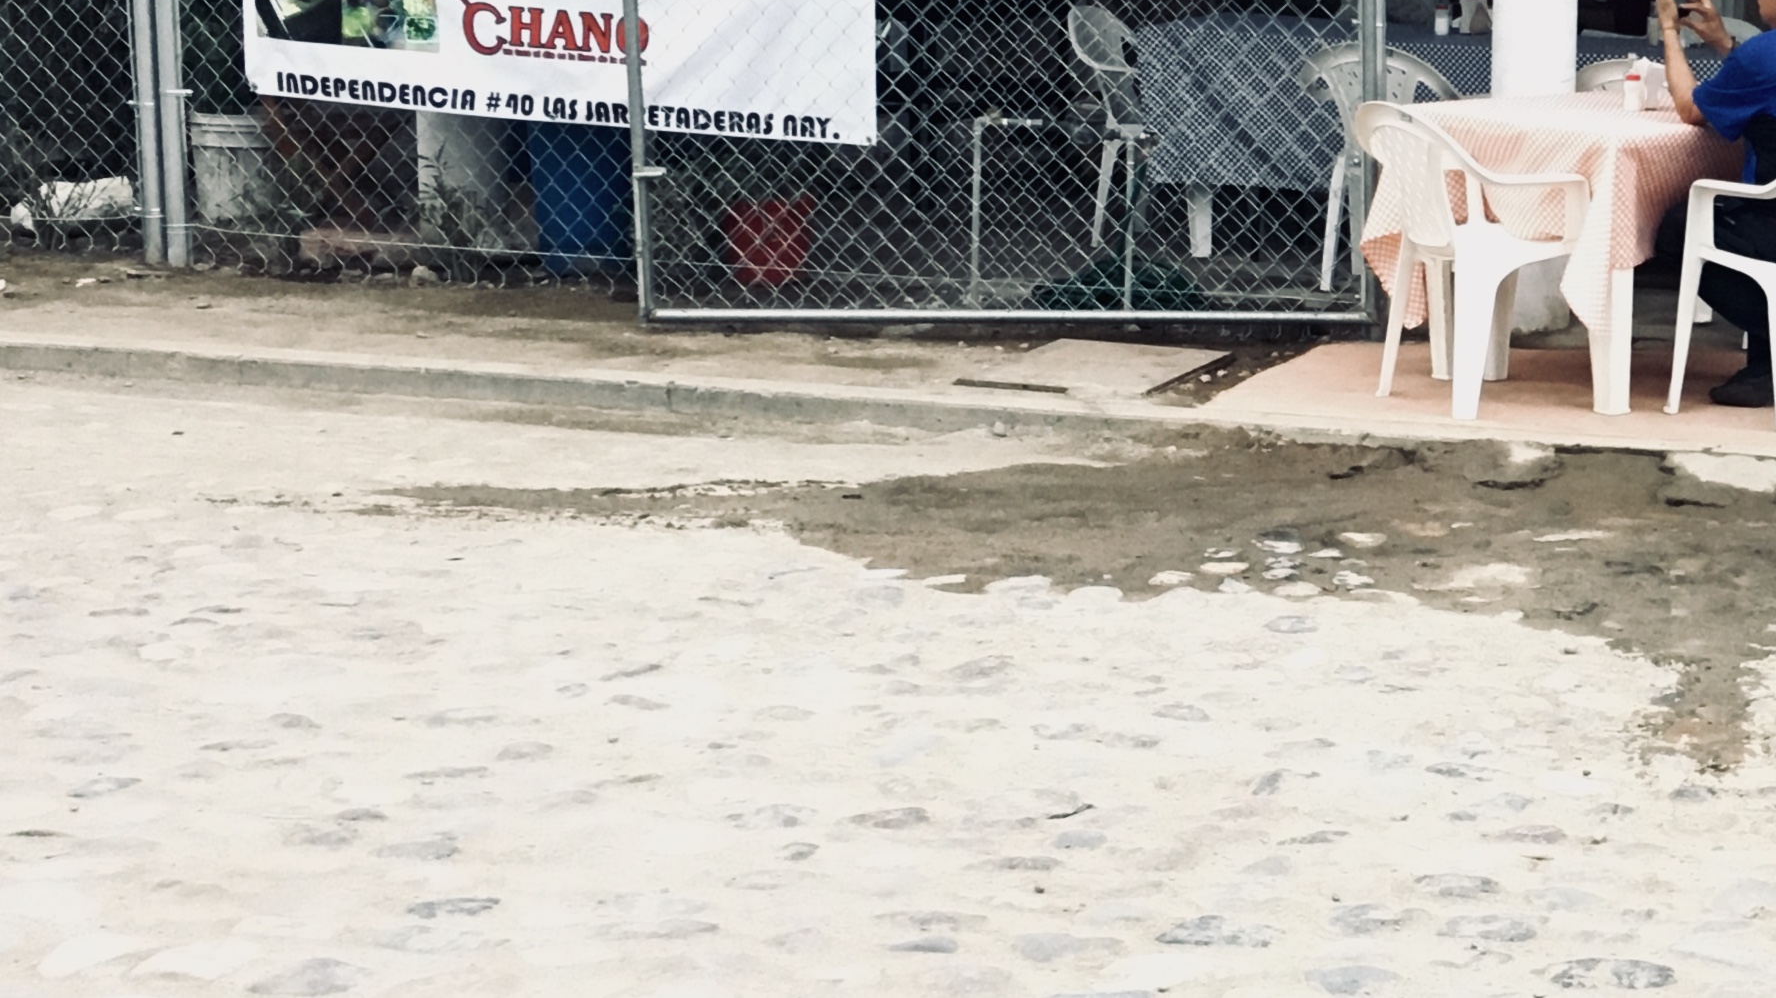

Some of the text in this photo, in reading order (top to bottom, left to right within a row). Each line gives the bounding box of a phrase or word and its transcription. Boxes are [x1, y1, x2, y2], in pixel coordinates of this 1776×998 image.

[276, 71, 841, 140] INDEPENDENCIA #40 LAS JARETADERAS NAY.
